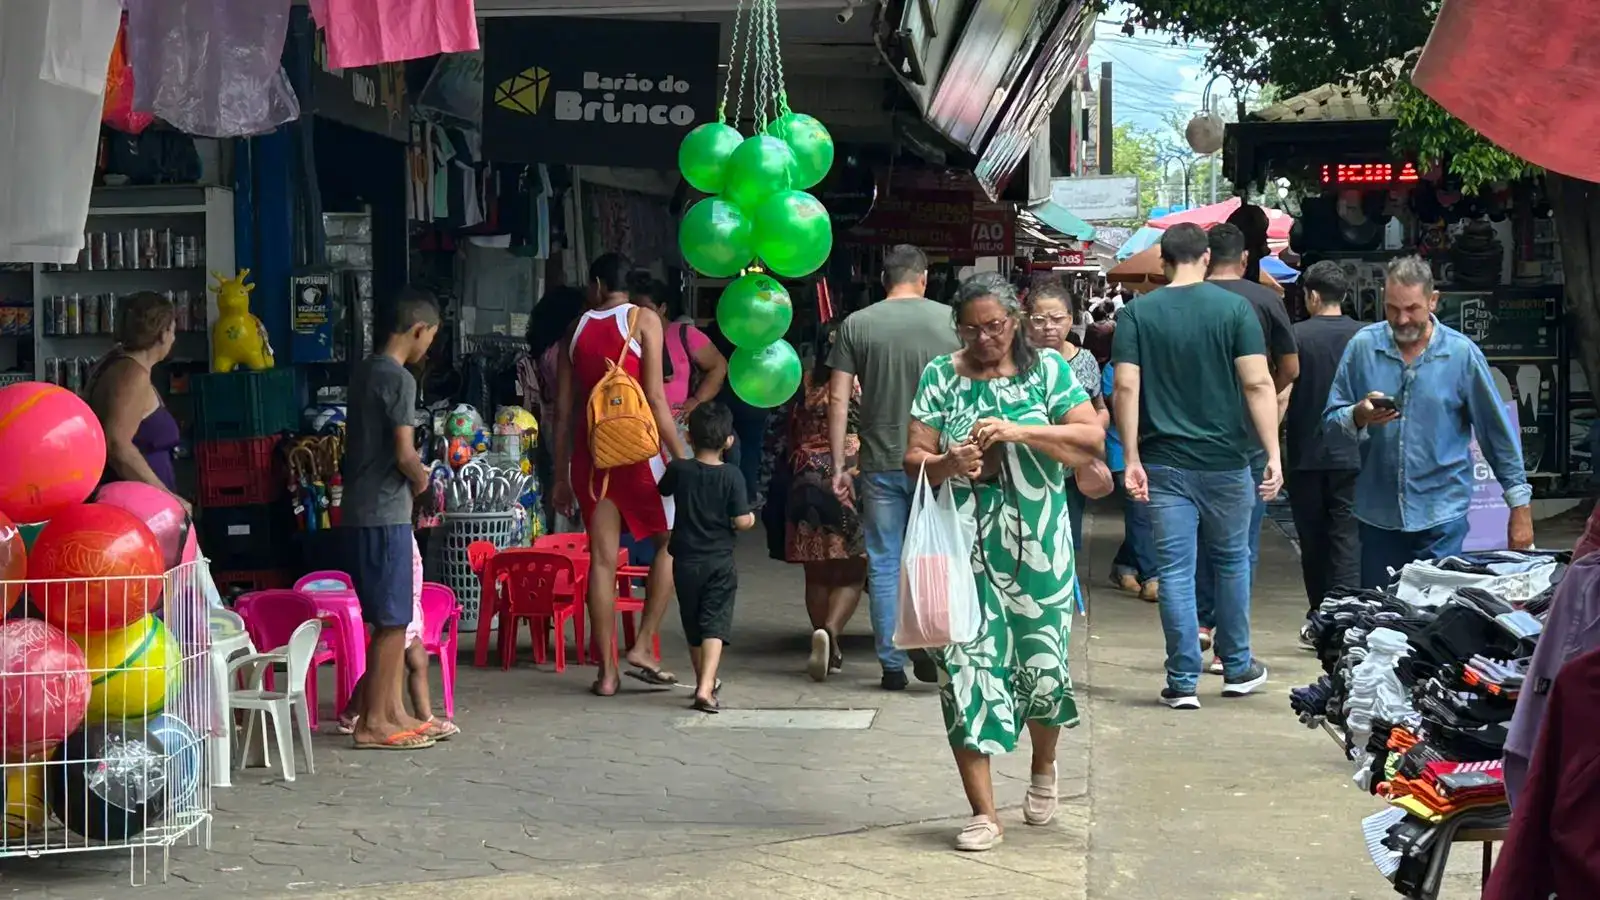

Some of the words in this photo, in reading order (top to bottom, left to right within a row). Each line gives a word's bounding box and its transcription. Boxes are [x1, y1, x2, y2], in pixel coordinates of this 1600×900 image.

[583, 71, 653, 92] Barão
[658, 75, 690, 93] do
[555, 90, 695, 125] Brinco
